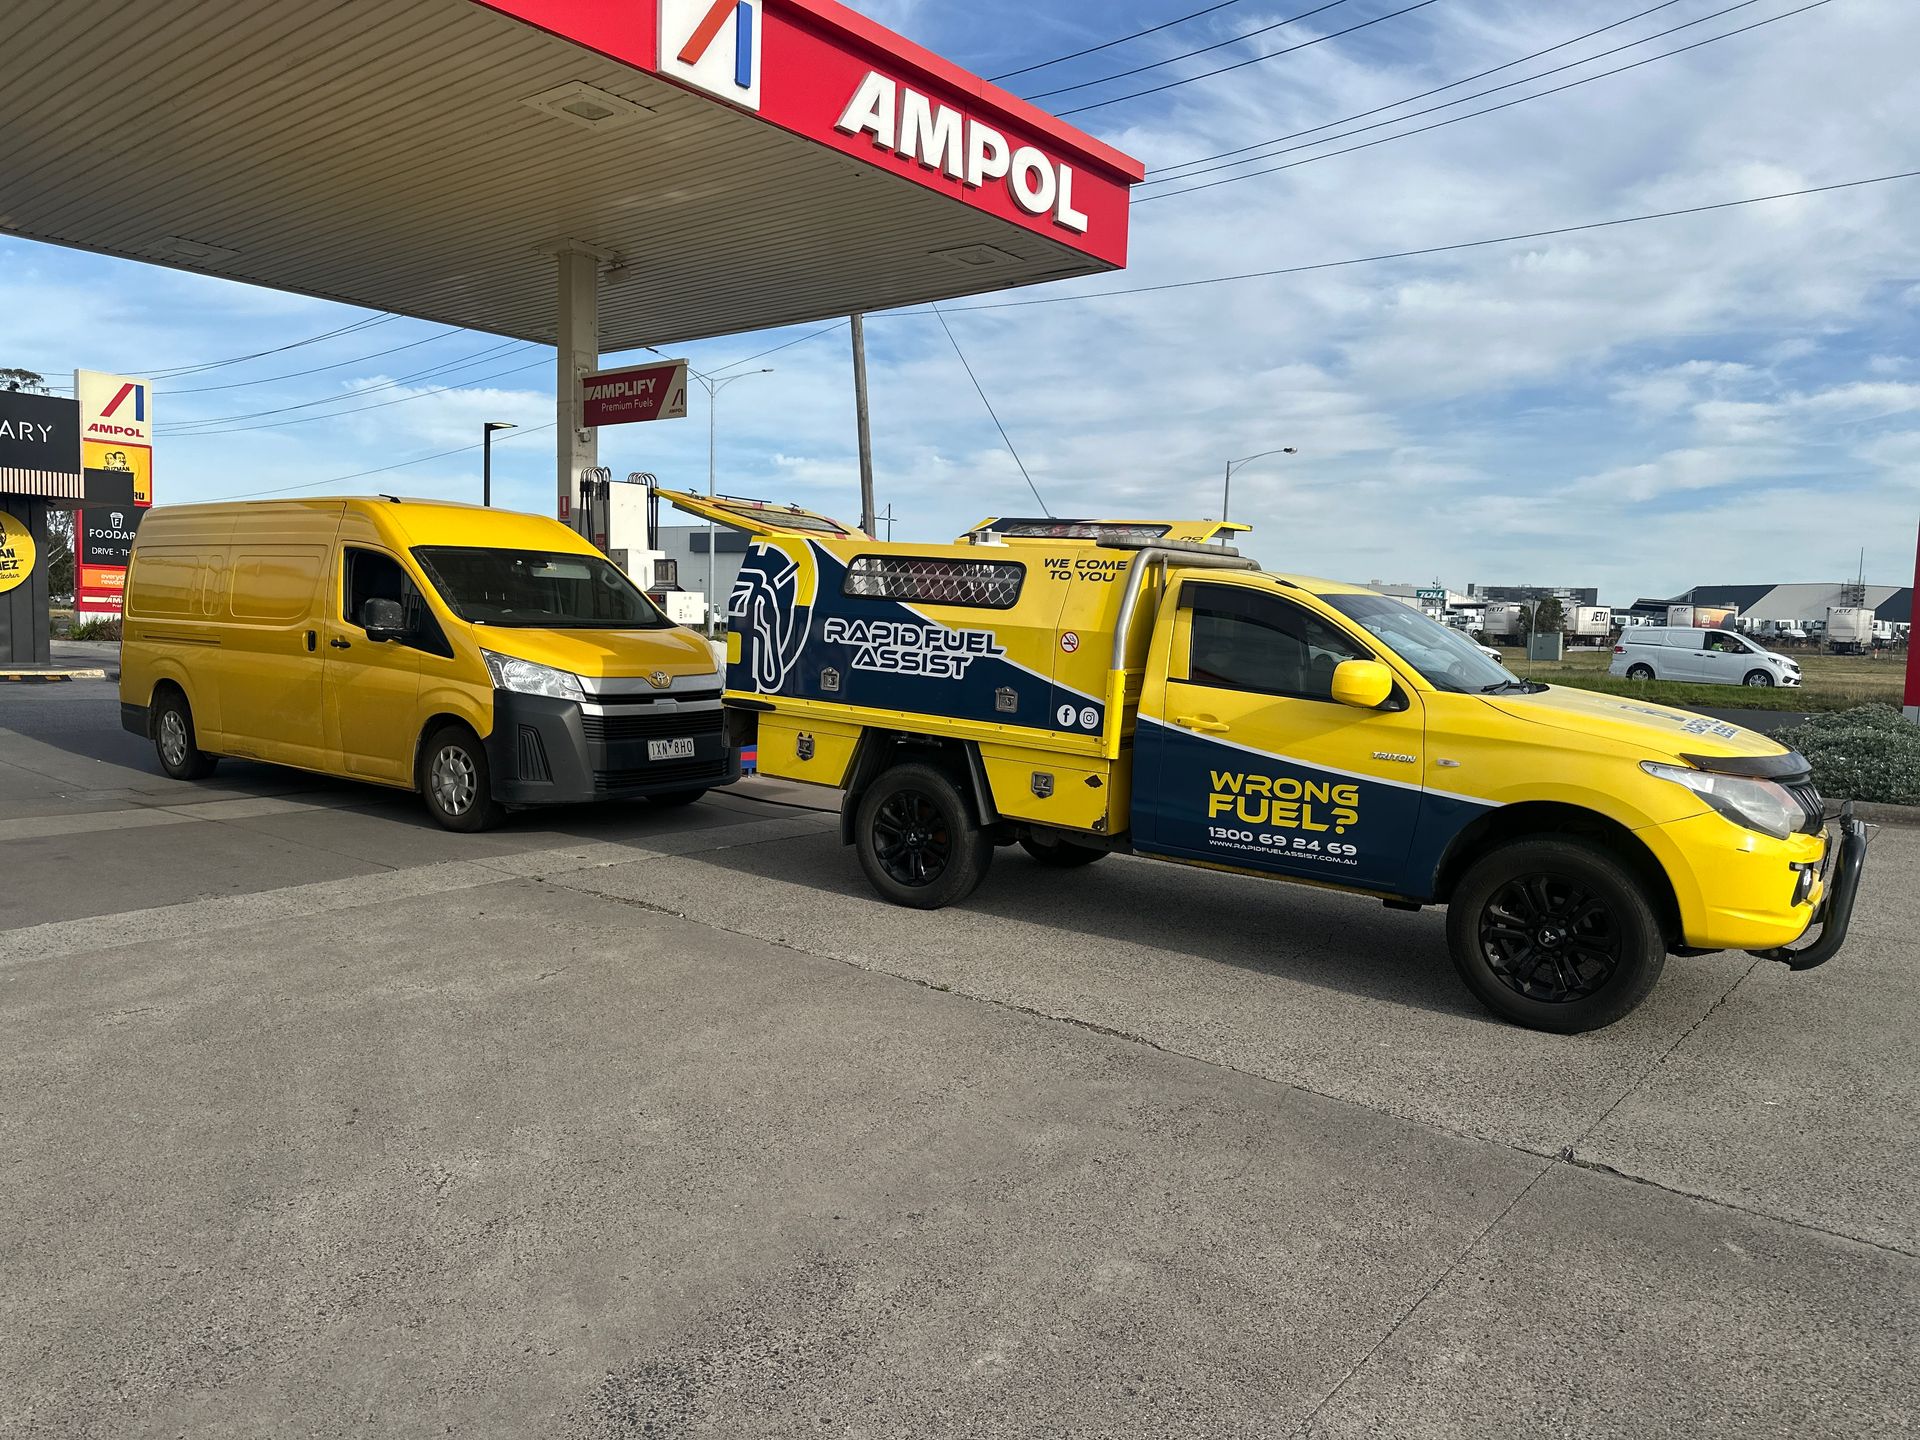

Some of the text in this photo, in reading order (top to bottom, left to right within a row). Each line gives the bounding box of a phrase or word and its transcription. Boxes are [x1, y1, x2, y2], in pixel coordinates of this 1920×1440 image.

[834, 70, 1088, 235] AMPOL
[591, 378, 656, 400] AMPLIFY
[601, 397, 653, 412] Premium Fuels
[0, 420, 52, 443] ARY
[88, 423, 144, 438] AMPOL
[91, 547, 113, 555] DRIVE
[1044, 558, 1129, 570] WE COME
[1049, 570, 1116, 582] TO YOU
[1417, 591, 1444, 599] TOLL
[1591, 611, 1607, 622] JETS
[852, 646, 973, 679] ASSIST
[1373, 751, 1416, 763] TRITON
[1210, 770, 1359, 807] WRONG
[1208, 793, 1359, 834] FUEL?
[1208, 826, 1358, 856] 1300 69 24 69
[1208, 839, 1358, 865] WWW.RAPIDFUELASSIST.COM.AU
